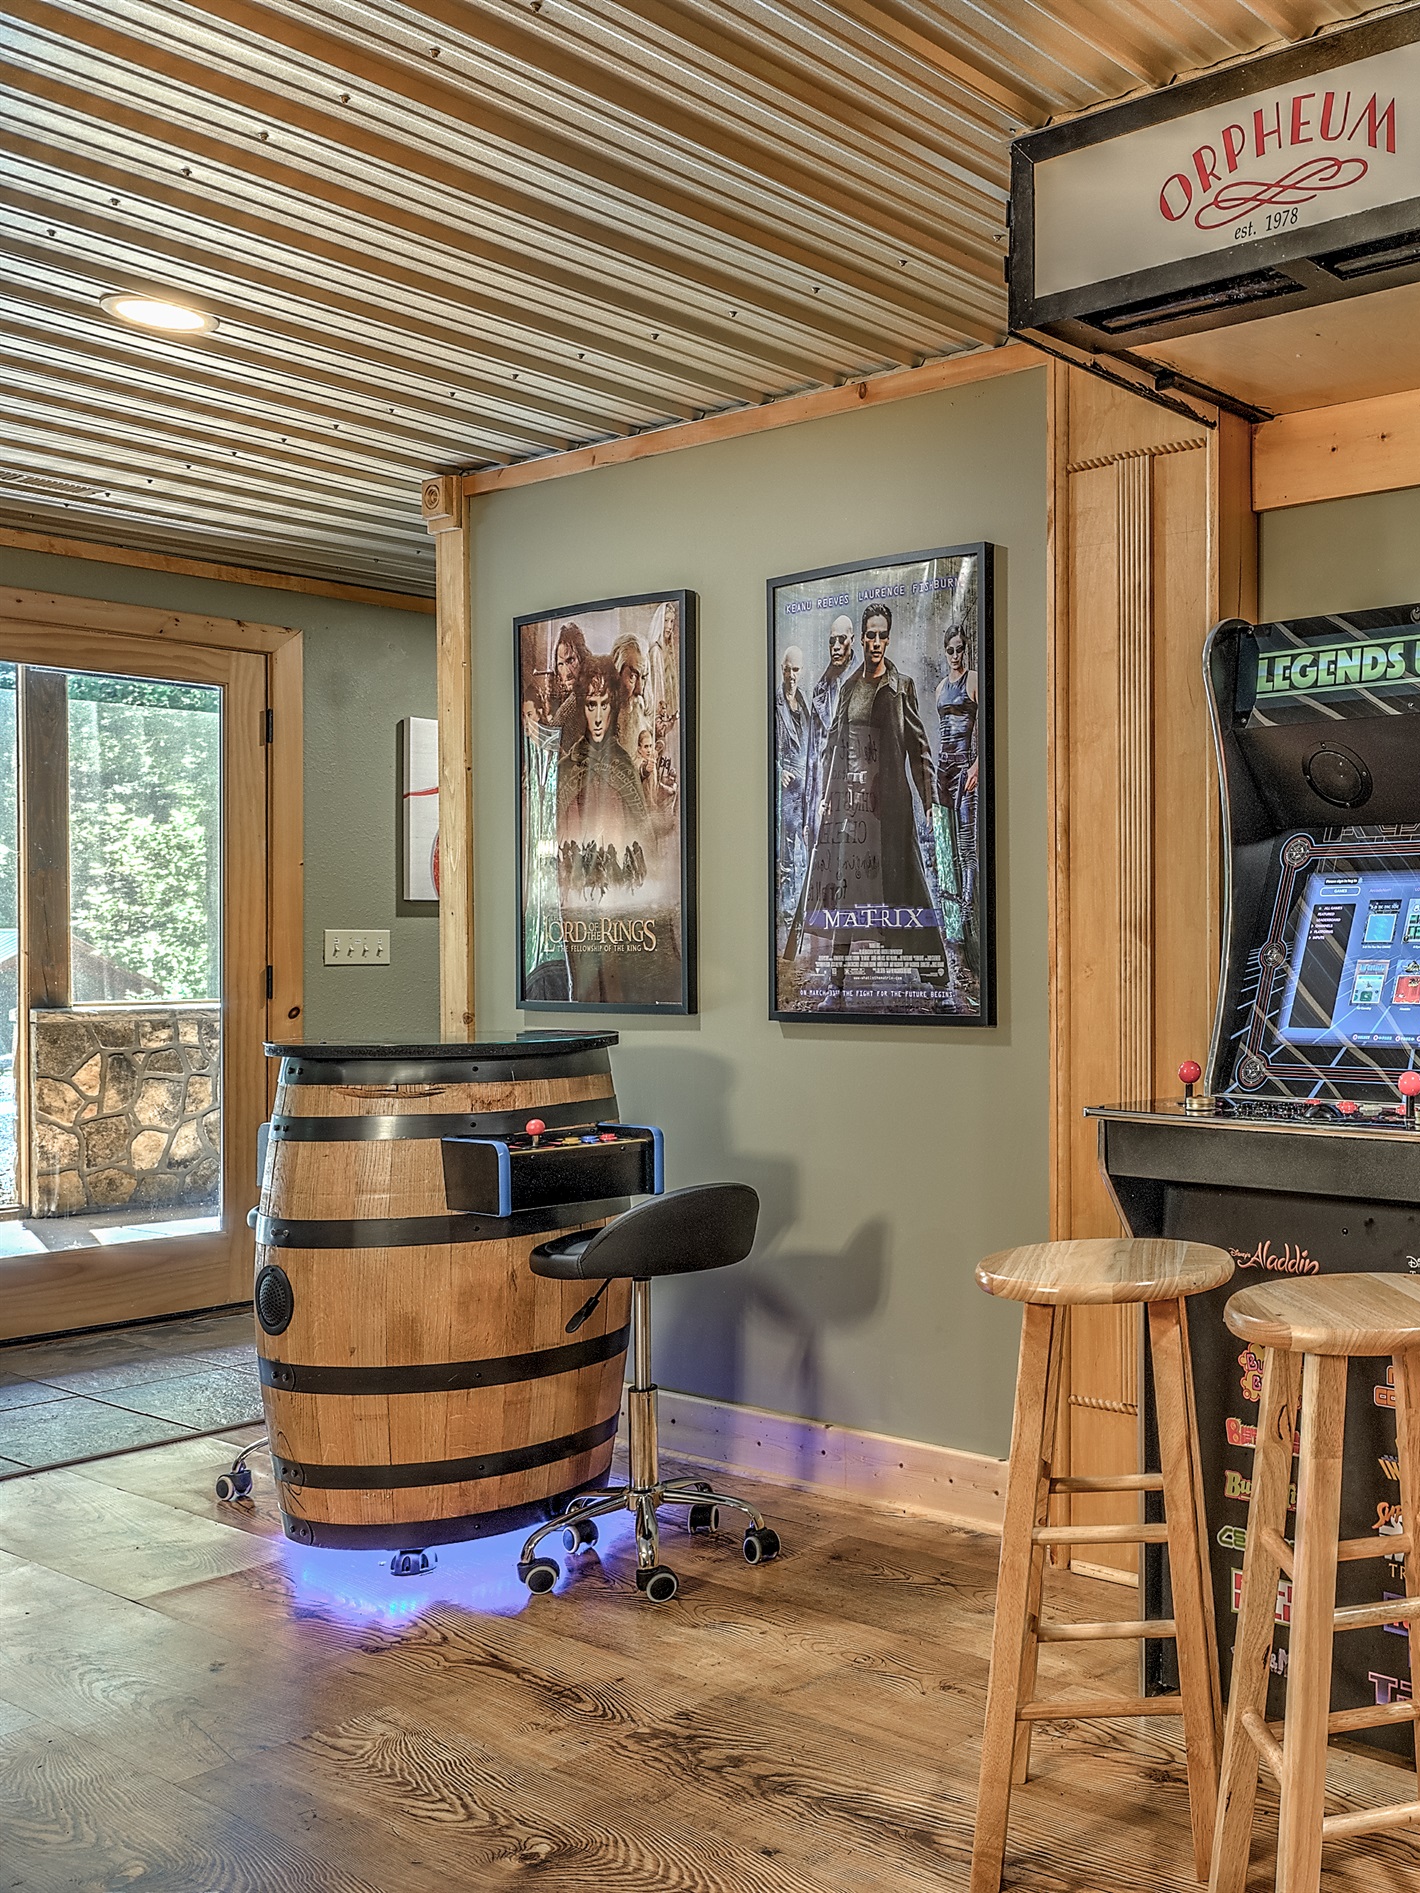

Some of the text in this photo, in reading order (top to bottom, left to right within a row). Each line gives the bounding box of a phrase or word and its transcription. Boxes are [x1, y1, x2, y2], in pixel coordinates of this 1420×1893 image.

[1159, 91, 1397, 222] ORPHEUM
[1234, 207, 1300, 241] est. 1978
[785, 576, 960, 614] KEANU REEVES LAURENCE FISHBURN
[1256, 642, 1404, 693] LEGENDS
[543, 916, 657, 952] LORD OF THE RINGS
[822, 908, 924, 930] MATRIX
[570, 944, 602, 952] FELLOWSHIP
[627, 944, 642, 952] RING
[904, 990, 927, 998] FUTURE
[1237, 1240, 1320, 1275] Aladdin
